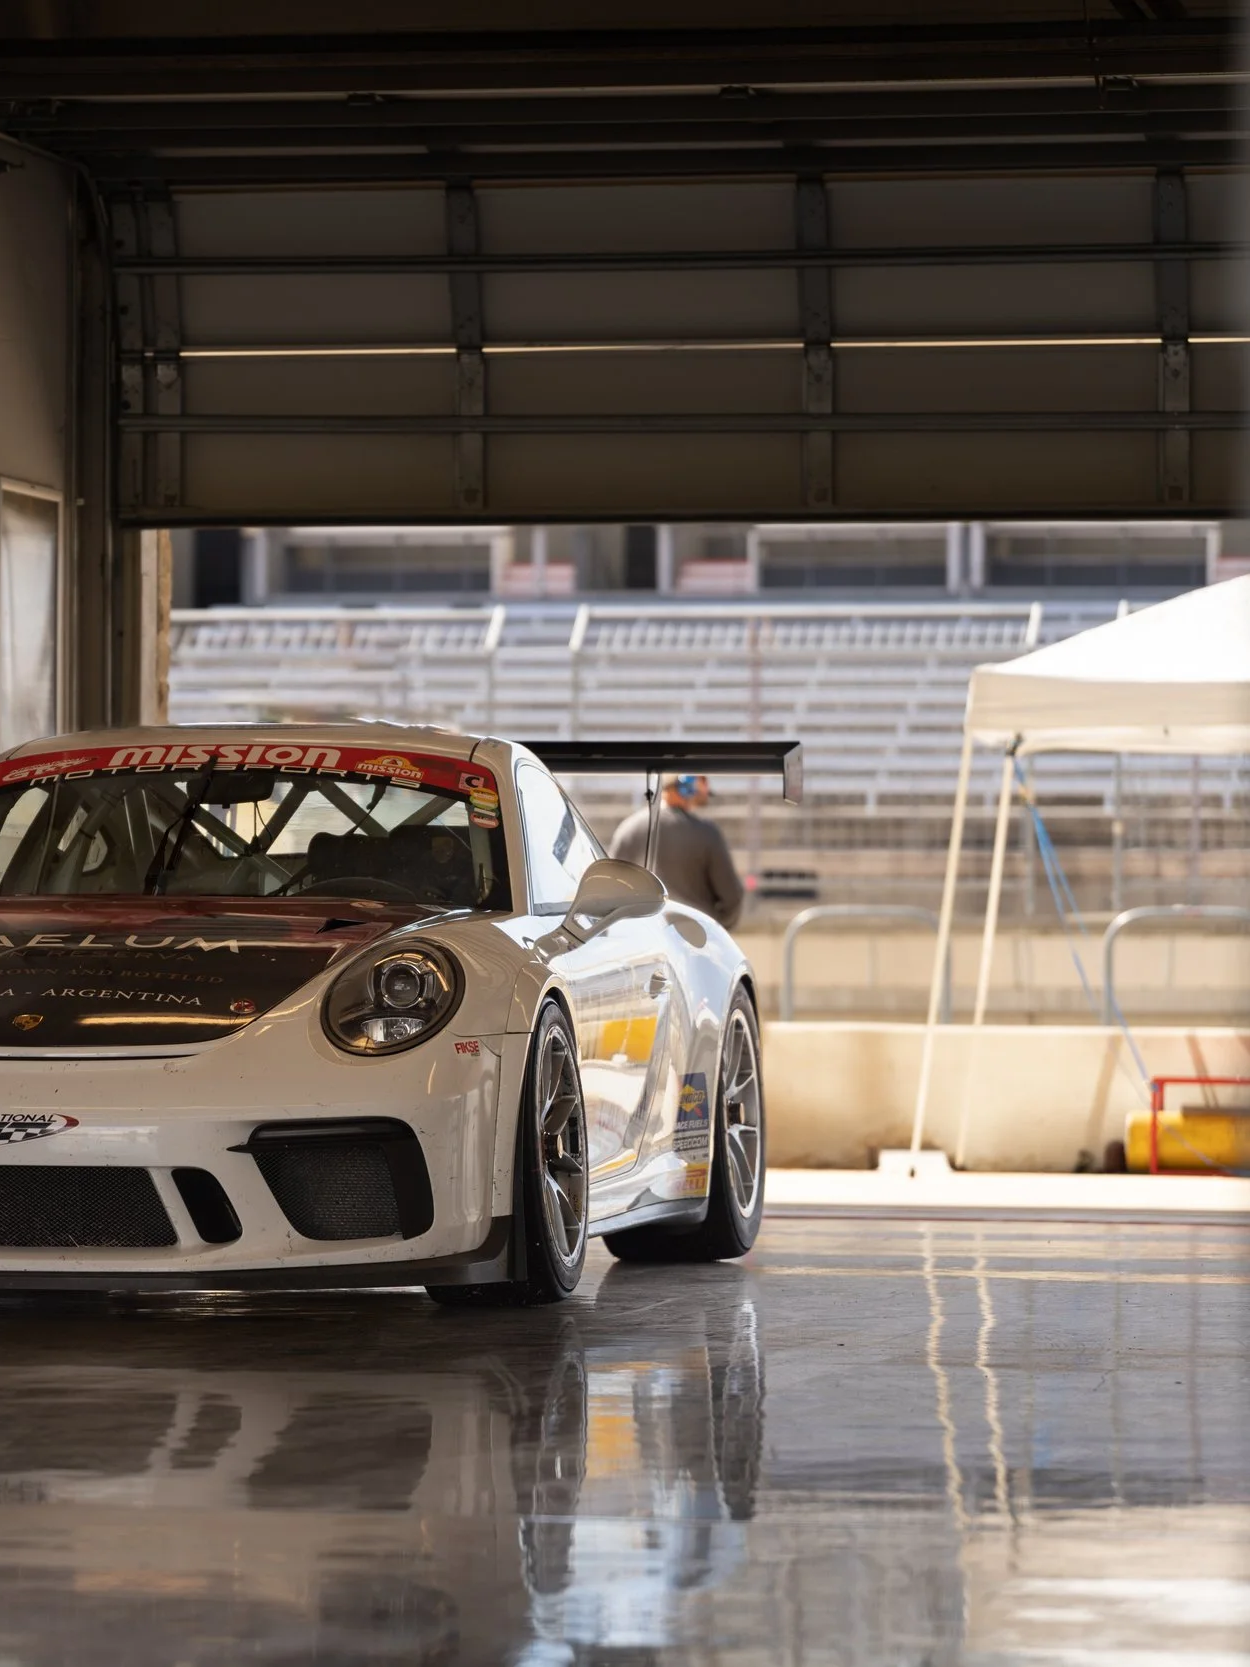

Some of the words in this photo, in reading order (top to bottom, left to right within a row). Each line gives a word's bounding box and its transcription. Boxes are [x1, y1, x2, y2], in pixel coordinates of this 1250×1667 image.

[465, 776, 481, 788] C
[46, 950, 195, 962] RESERVA
[69, 967, 113, 977] AND
[119, 969, 225, 984] BOTTLED
[40, 987, 203, 1007] ARGENTINA
[454, 1040, 480, 1054] FIKSE
[689, 1118, 708, 1129] FUELS
